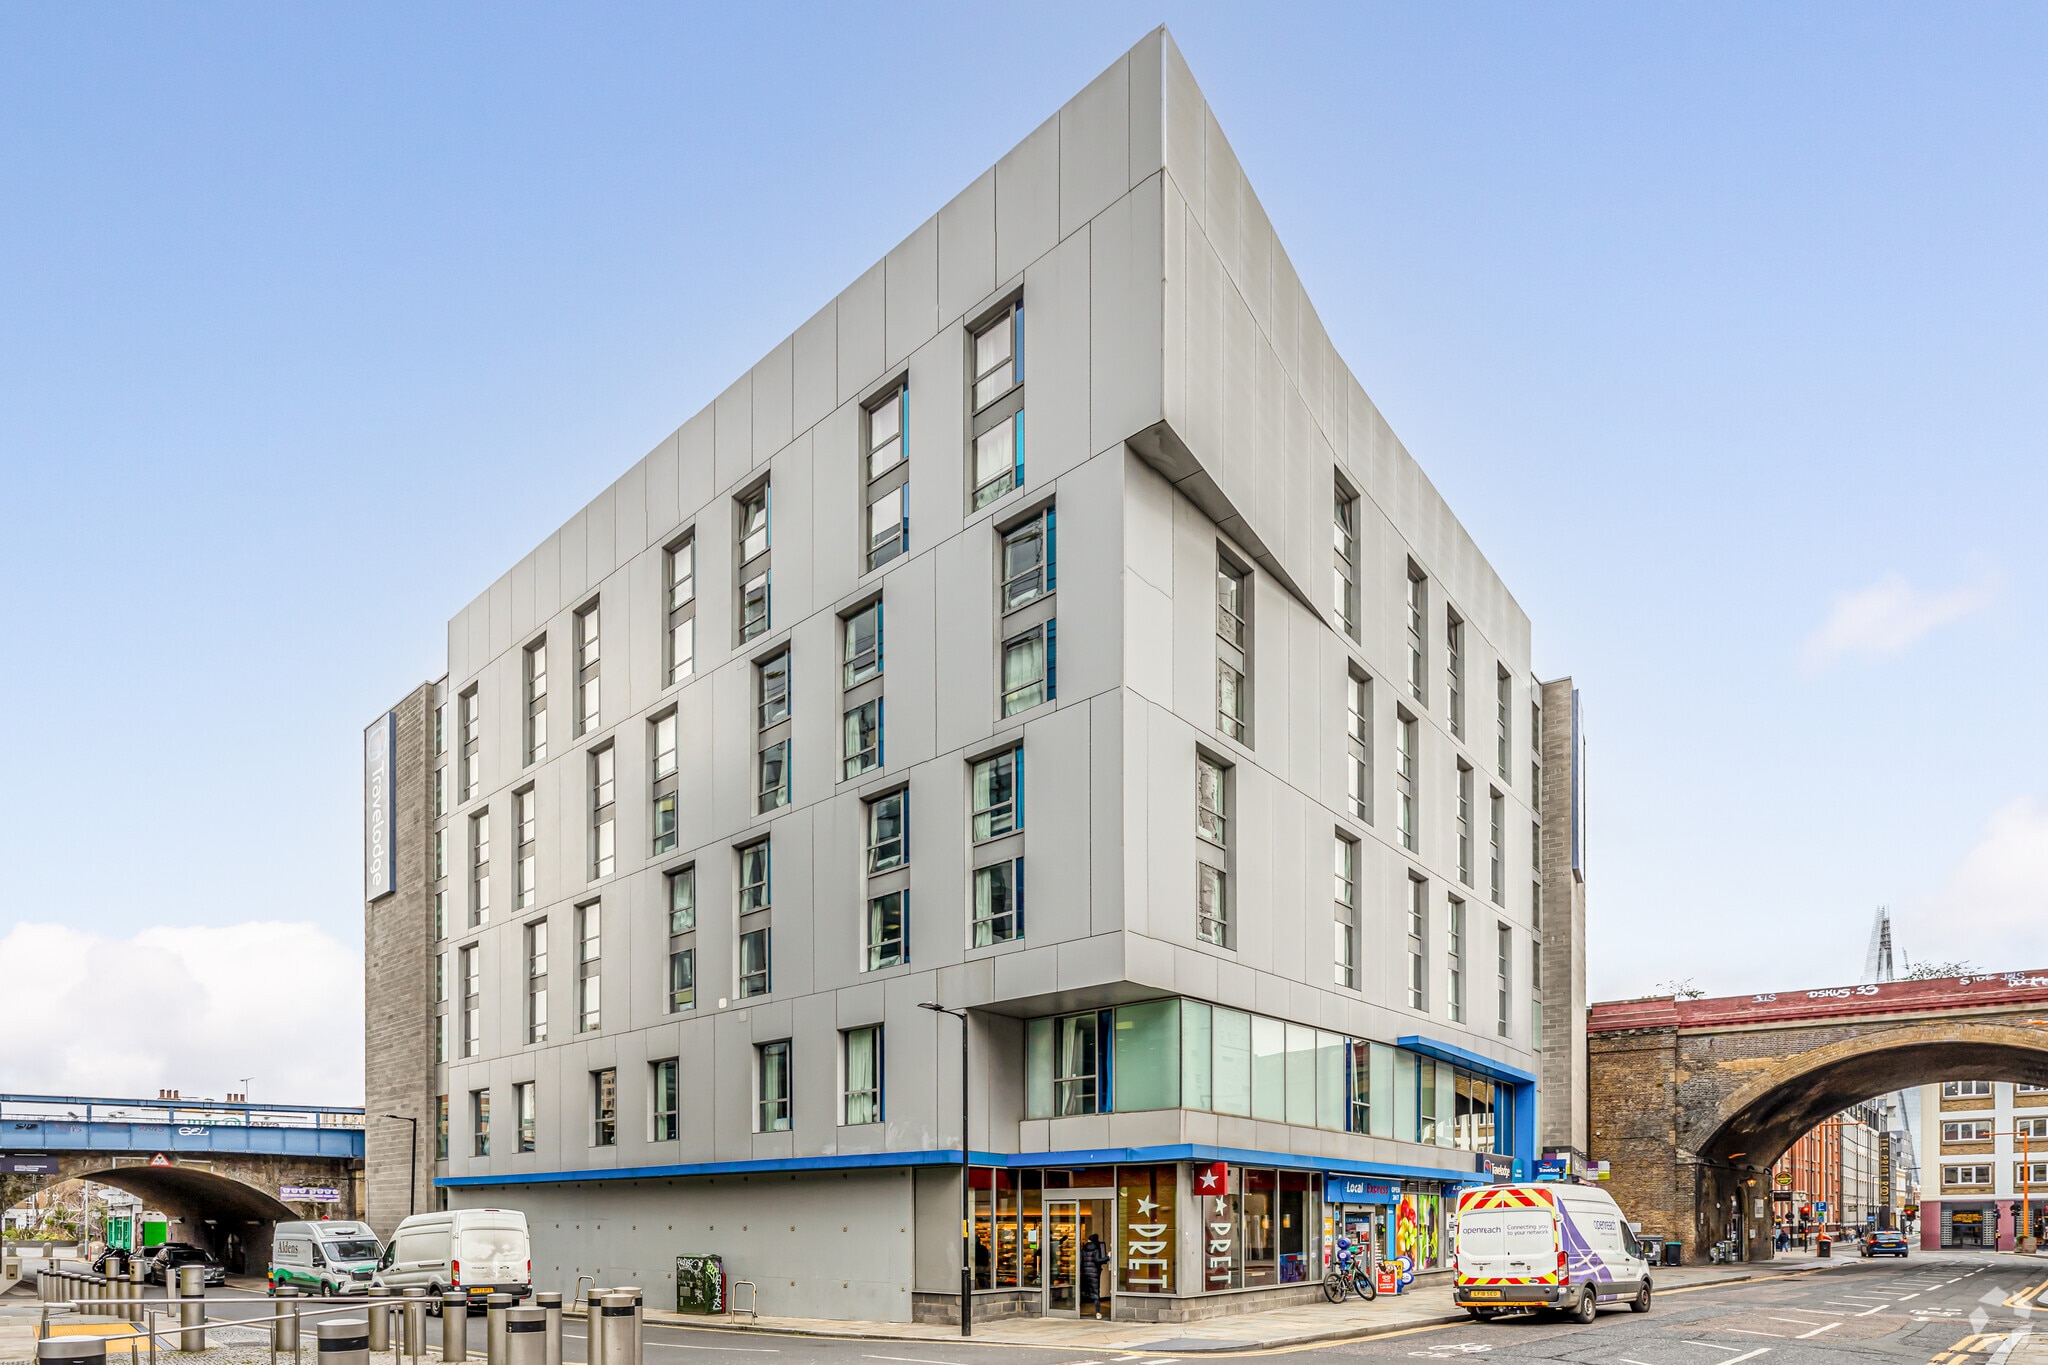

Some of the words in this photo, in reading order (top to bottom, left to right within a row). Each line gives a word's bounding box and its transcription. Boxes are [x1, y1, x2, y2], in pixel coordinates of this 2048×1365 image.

[370, 760, 385, 886] Travelodge
[1491, 1162, 1510, 1178] Travelodge
[1346, 1181, 1364, 1194] Local
[1365, 1183, 1389, 1195] Express
[1462, 1226, 1502, 1235] openreach
[277, 1240, 299, 1255] Aldens
[1209, 1222, 1232, 1284] PRET
[1128, 1223, 1168, 1289] PRET
